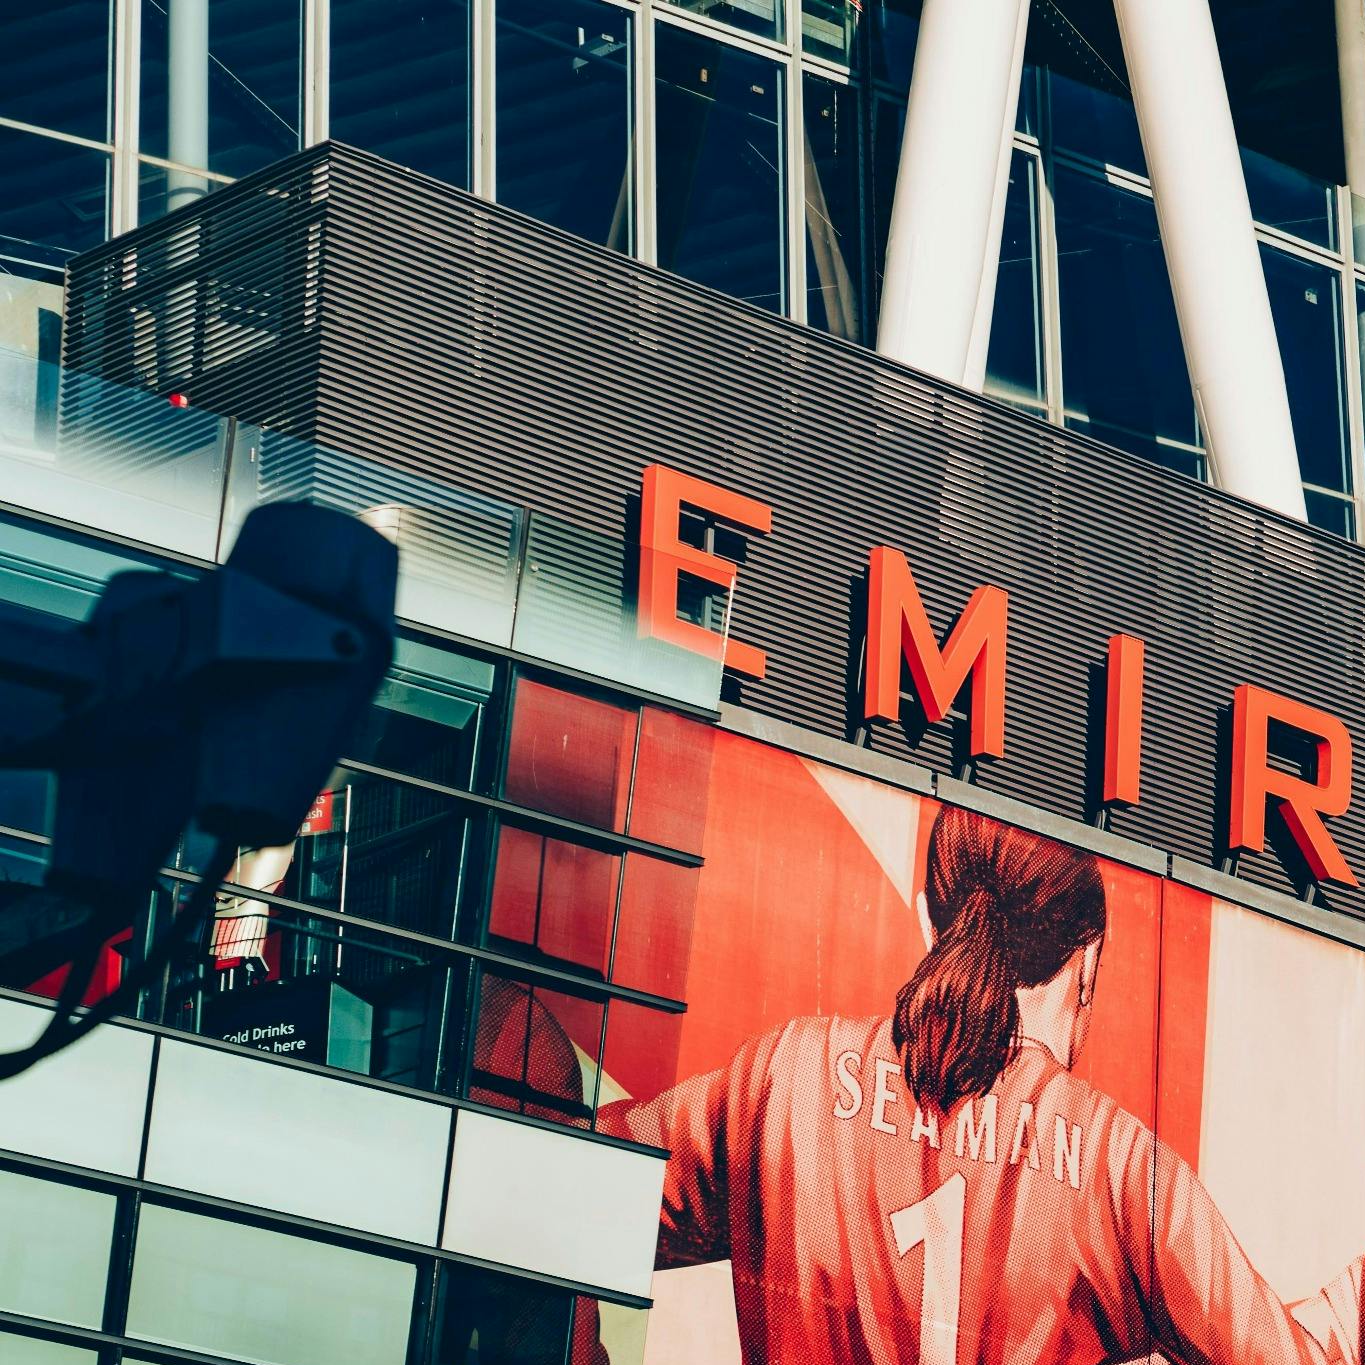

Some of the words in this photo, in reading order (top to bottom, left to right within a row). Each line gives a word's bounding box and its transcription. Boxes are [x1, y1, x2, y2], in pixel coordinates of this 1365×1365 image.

[252, 1023, 295, 1041] Drinks
[273, 1039, 307, 1053] here
[833, 1050, 1083, 1190] SEAMAN
